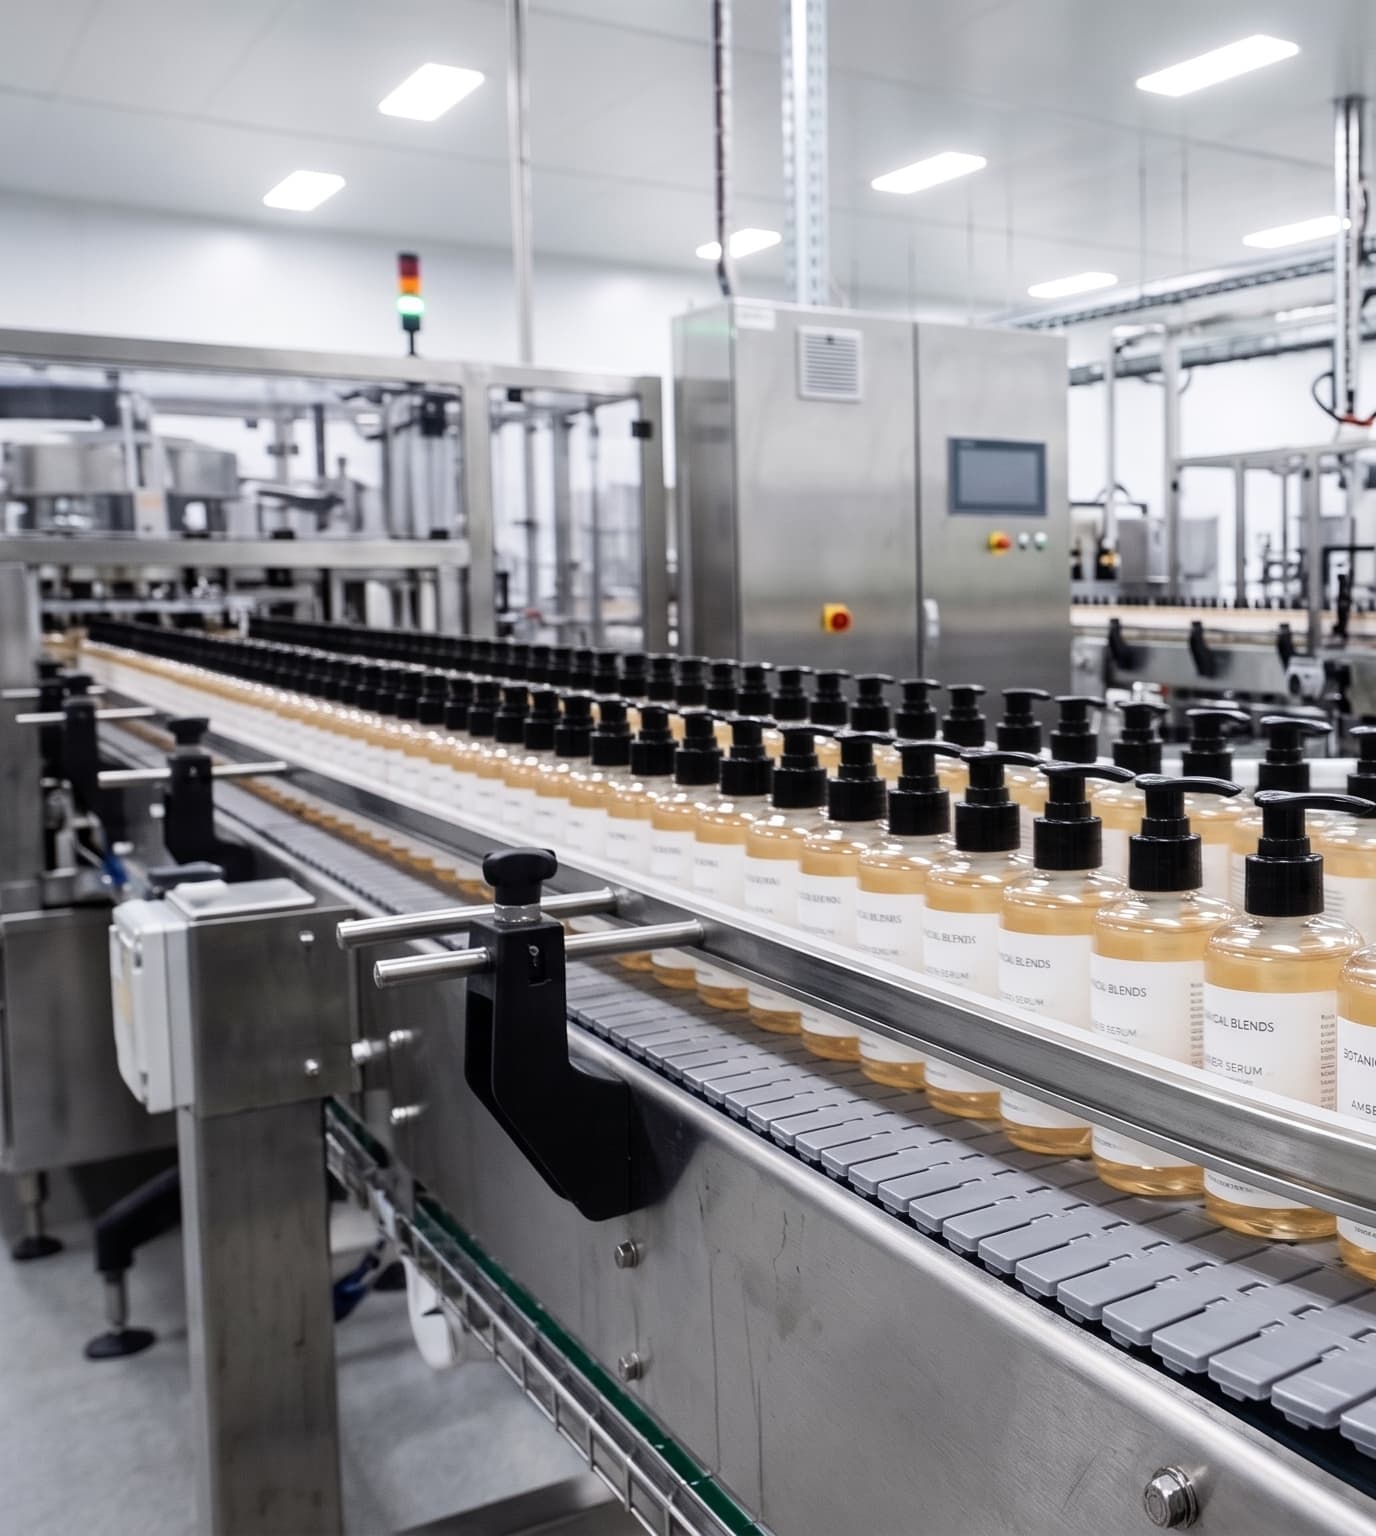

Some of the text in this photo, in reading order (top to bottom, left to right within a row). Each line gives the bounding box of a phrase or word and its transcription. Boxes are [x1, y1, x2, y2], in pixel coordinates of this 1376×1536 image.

[1108, 984, 1147, 997] BLENDS
[1231, 1018, 1275, 1033] BLENDS
[1225, 1062, 1263, 1077] SERUM
